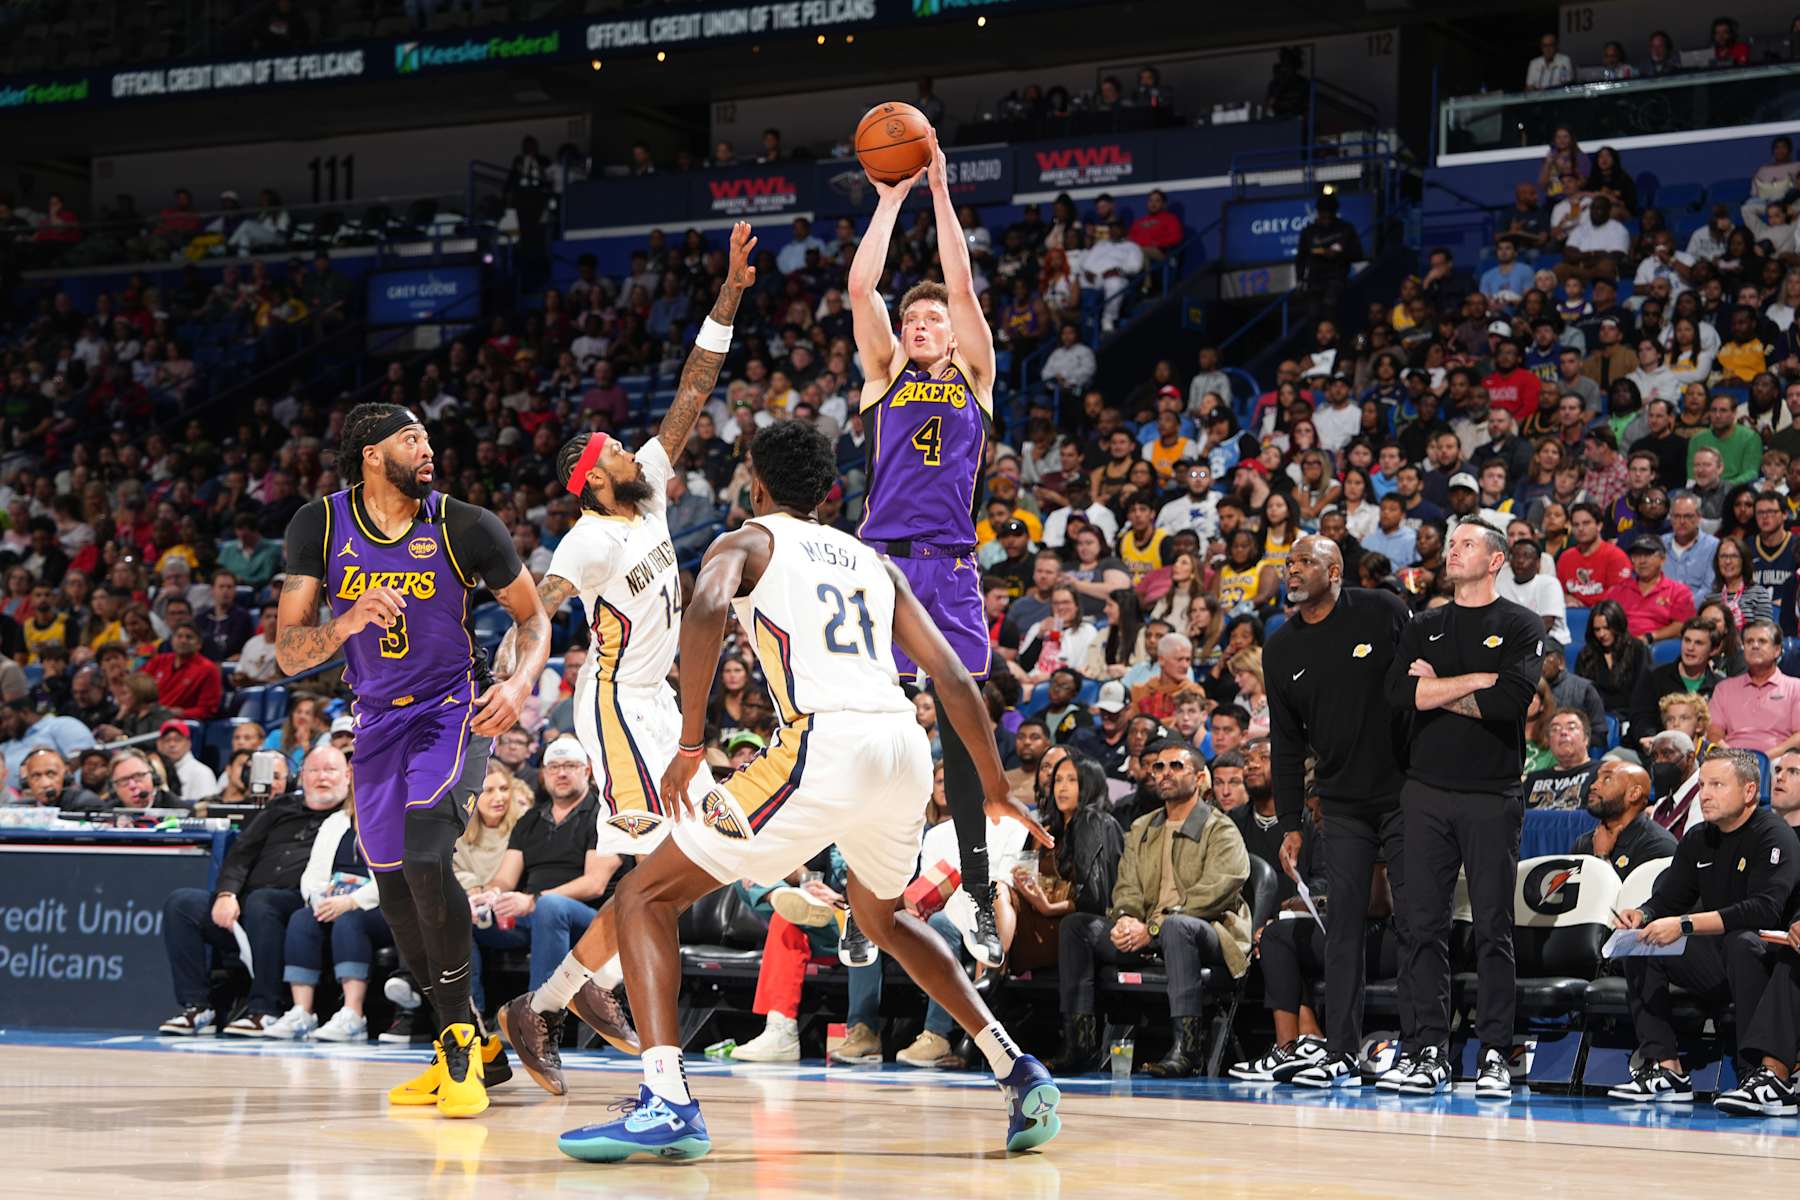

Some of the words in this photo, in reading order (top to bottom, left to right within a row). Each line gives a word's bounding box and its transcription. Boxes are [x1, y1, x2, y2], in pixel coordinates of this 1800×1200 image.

[586, 19, 649, 50] OFFICIAL
[650, 12, 700, 43] CREDIT
[702, 8, 748, 37] UNION
[749, 5, 769, 32] OF
[771, 1, 800, 30] THE
[801, 0, 875, 26] PELICANS
[1565, 9, 1593, 33] 113
[420, 30, 561, 65] KeeslerFederal
[1367, 35, 1393, 56] 112
[111, 70, 166, 98] OFFICIAL
[167, 65, 212, 92] CREDIT
[213, 61, 254, 88] UNION
[255, 59, 273, 84] OF
[274, 56, 299, 81] THE
[300, 50, 365, 80] PELICANS
[960, 158, 1002, 183] RADIO
[1034, 145, 1133, 171] WWL
[308, 154, 354, 203] 111
[709, 176, 797, 201] WWL
[1251, 217, 1289, 235] GREY
[387, 284, 416, 300] GREY
[417, 281, 457, 298] GOOSE
[911, 415, 942, 466] 4
[411, 542, 435, 552] bibigo
[800, 540, 856, 571] MISSI
[336, 565, 436, 600] LAKERS
[625, 557, 655, 597] NEW
[648, 539, 675, 573] ORLE
[659, 574, 682, 630] 14
[378, 612, 409, 659] 3
[816, 582, 878, 661] 21
[1532, 771, 1590, 792] BRYANT
[1523, 859, 1582, 916] G
